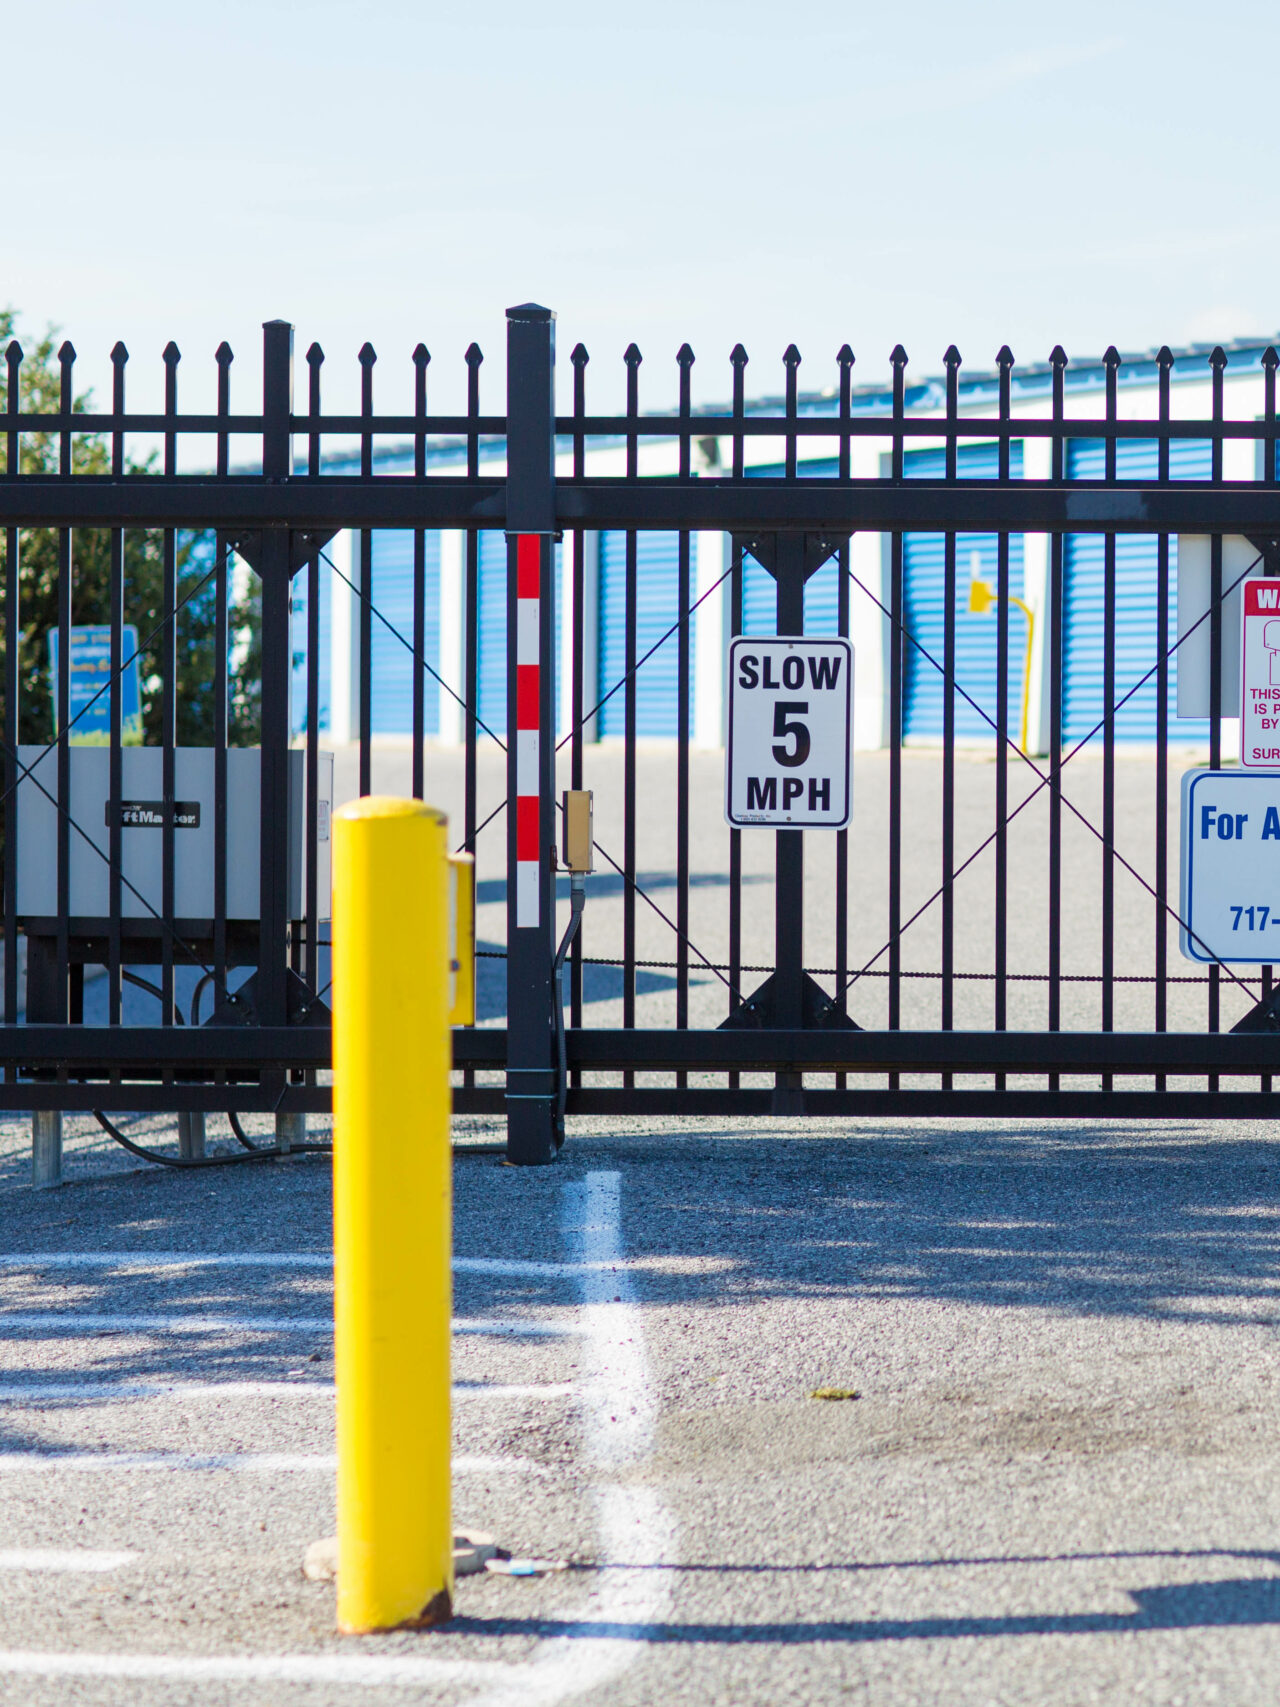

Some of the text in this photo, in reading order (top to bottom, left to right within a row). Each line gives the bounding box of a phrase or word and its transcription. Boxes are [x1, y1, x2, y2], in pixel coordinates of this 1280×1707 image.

[738, 655, 842, 690] SLOW
[1250, 688, 1280, 700] THIS
[1254, 703, 1268, 715] IS
[771, 701, 811, 768] 5
[1261, 718, 1280, 730] BY
[746, 777, 831, 811] MPH
[1200, 805, 1249, 841] For
